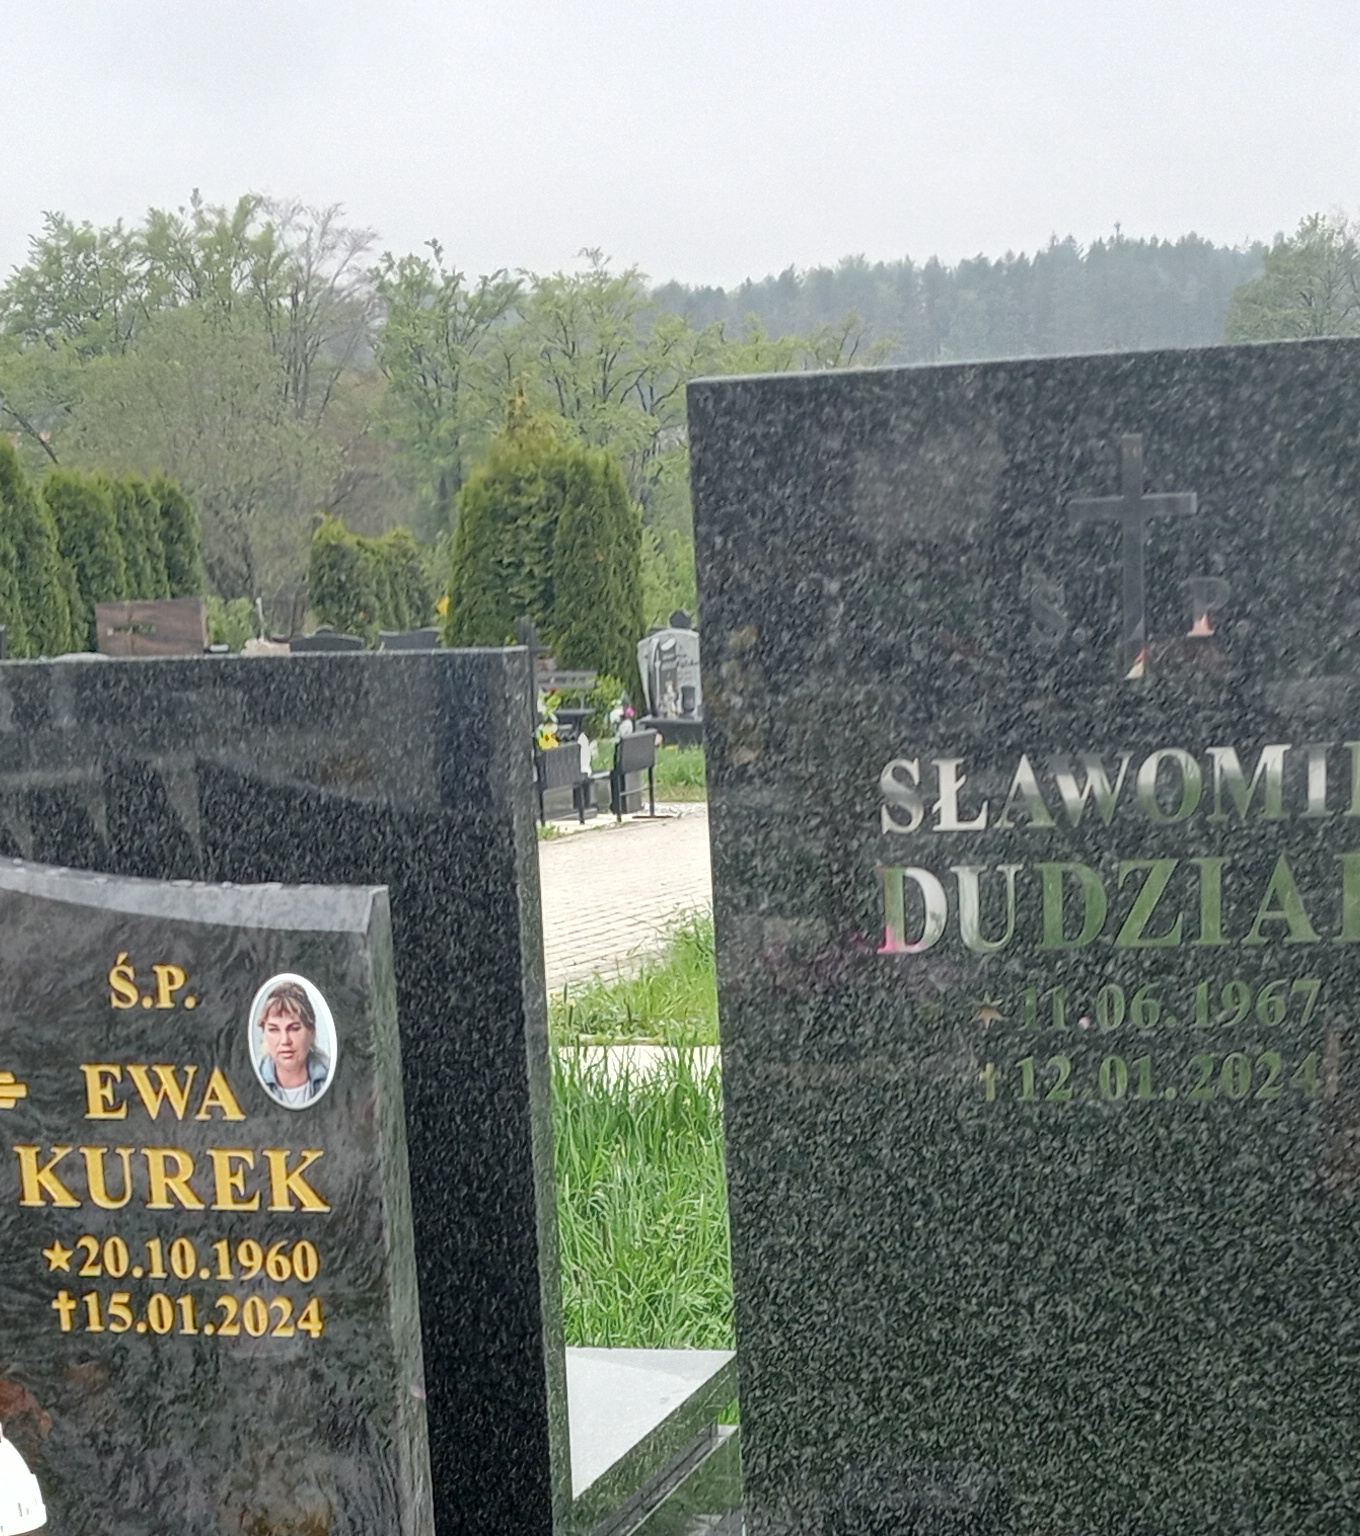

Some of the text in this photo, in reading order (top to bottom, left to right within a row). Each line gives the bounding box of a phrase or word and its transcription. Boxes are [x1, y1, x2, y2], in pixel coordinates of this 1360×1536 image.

[109, 951, 198, 1010] Ś.P.
[81, 1063, 246, 1121] EWA
[14, 1144, 330, 1213] KUREK
